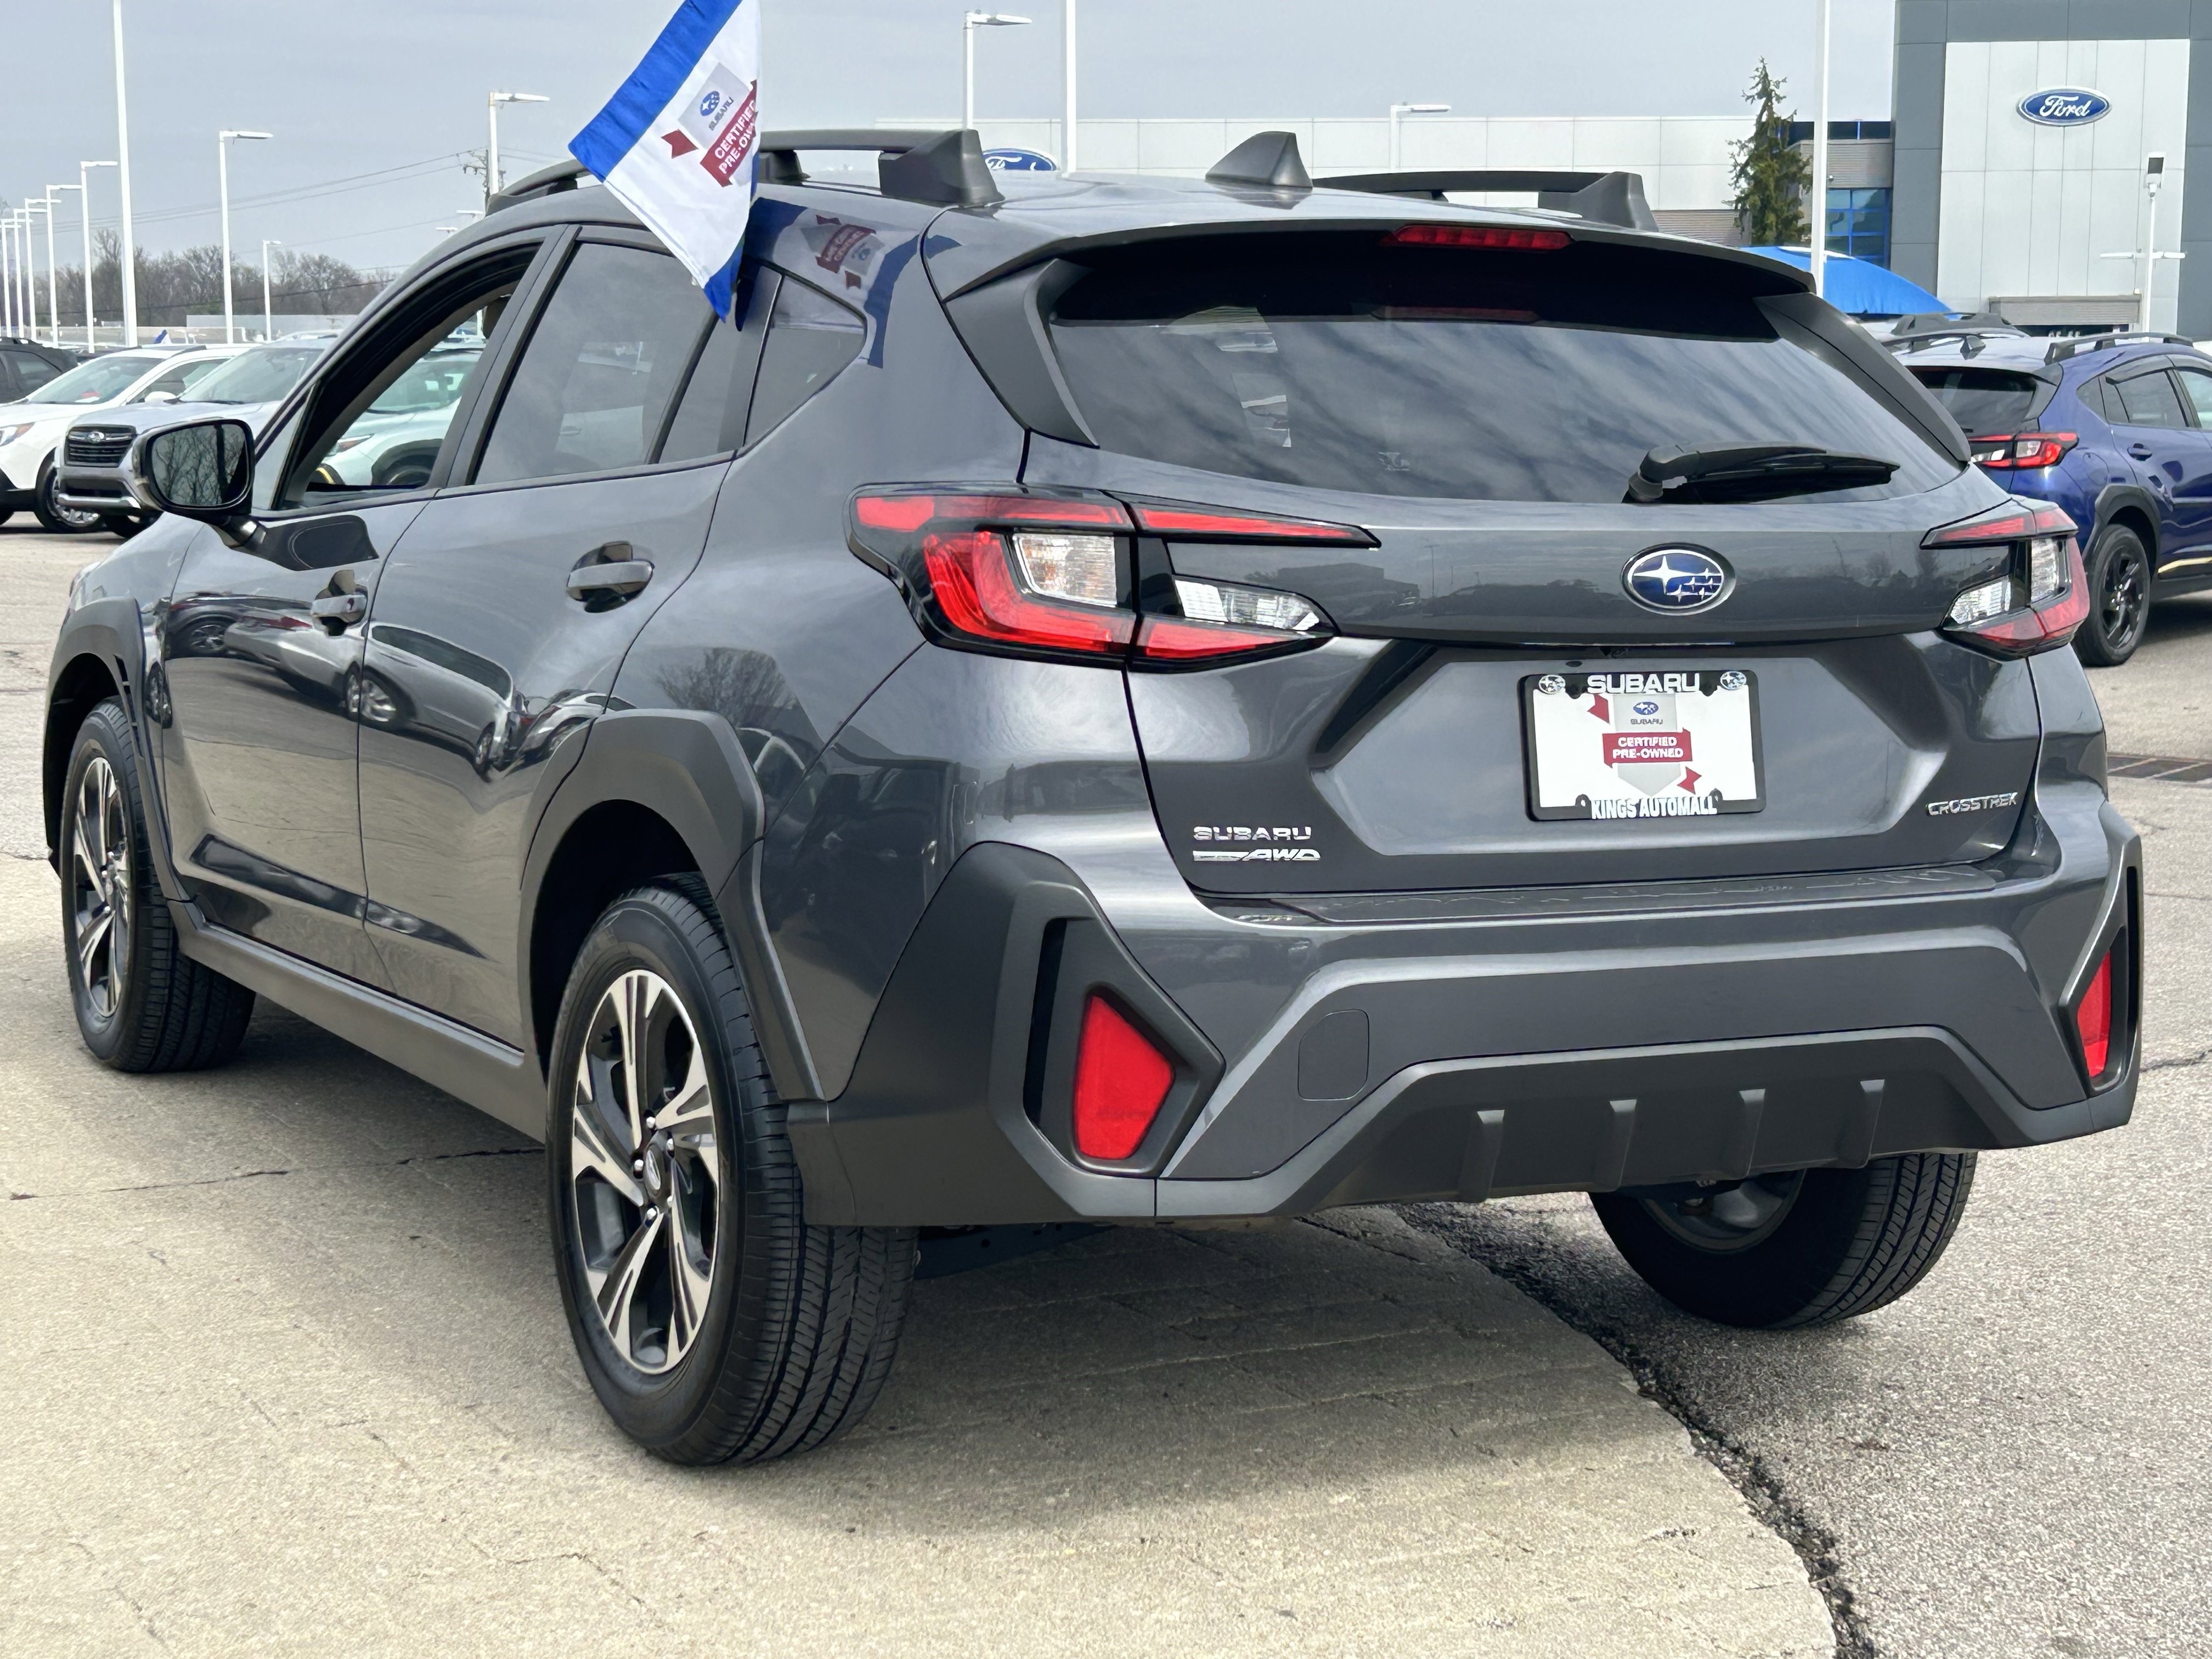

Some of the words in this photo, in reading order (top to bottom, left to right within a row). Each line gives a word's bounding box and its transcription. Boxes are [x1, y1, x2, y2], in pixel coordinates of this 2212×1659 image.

[2039, 95, 2092, 117] Ford
[1587, 673, 1700, 694] SUBARU
[1618, 736, 1677, 747] CERTIFIED
[1612, 747, 1684, 759] PRE-OWNED
[1591, 798, 1640, 820] KINGS
[1639, 795, 1718, 817] AUTOMALL
[1928, 792, 2018, 816] CROSSTREK
[1193, 826, 1312, 840] SUBARU
[1242, 849, 1321, 861] AWD
